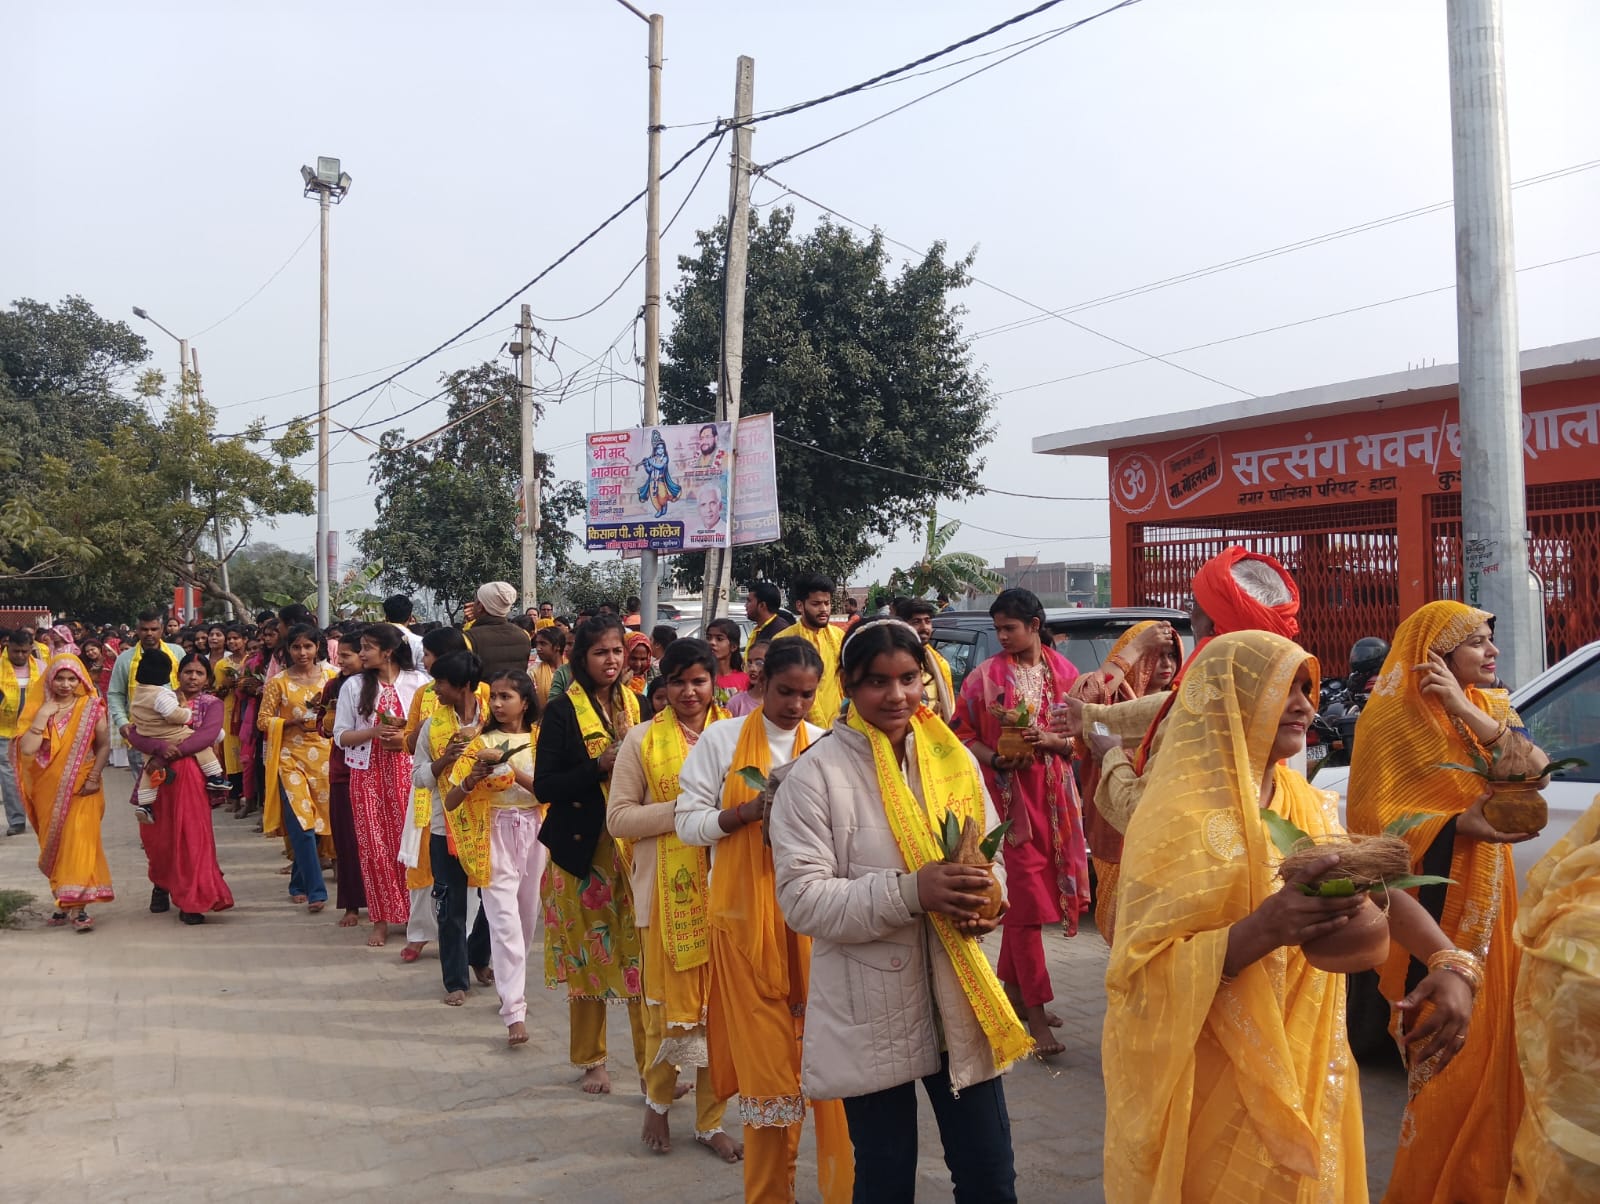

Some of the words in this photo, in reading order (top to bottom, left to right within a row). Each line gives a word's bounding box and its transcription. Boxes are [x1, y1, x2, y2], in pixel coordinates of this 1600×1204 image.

[593, 445, 606, 460] श्री
[1231, 432, 1349, 486] सत्संग
[591, 465, 630, 478] भागवत
[598, 484, 622, 496] कथा
[588, 526, 618, 540] किसान
[649, 522, 681, 538] कॉलेज
